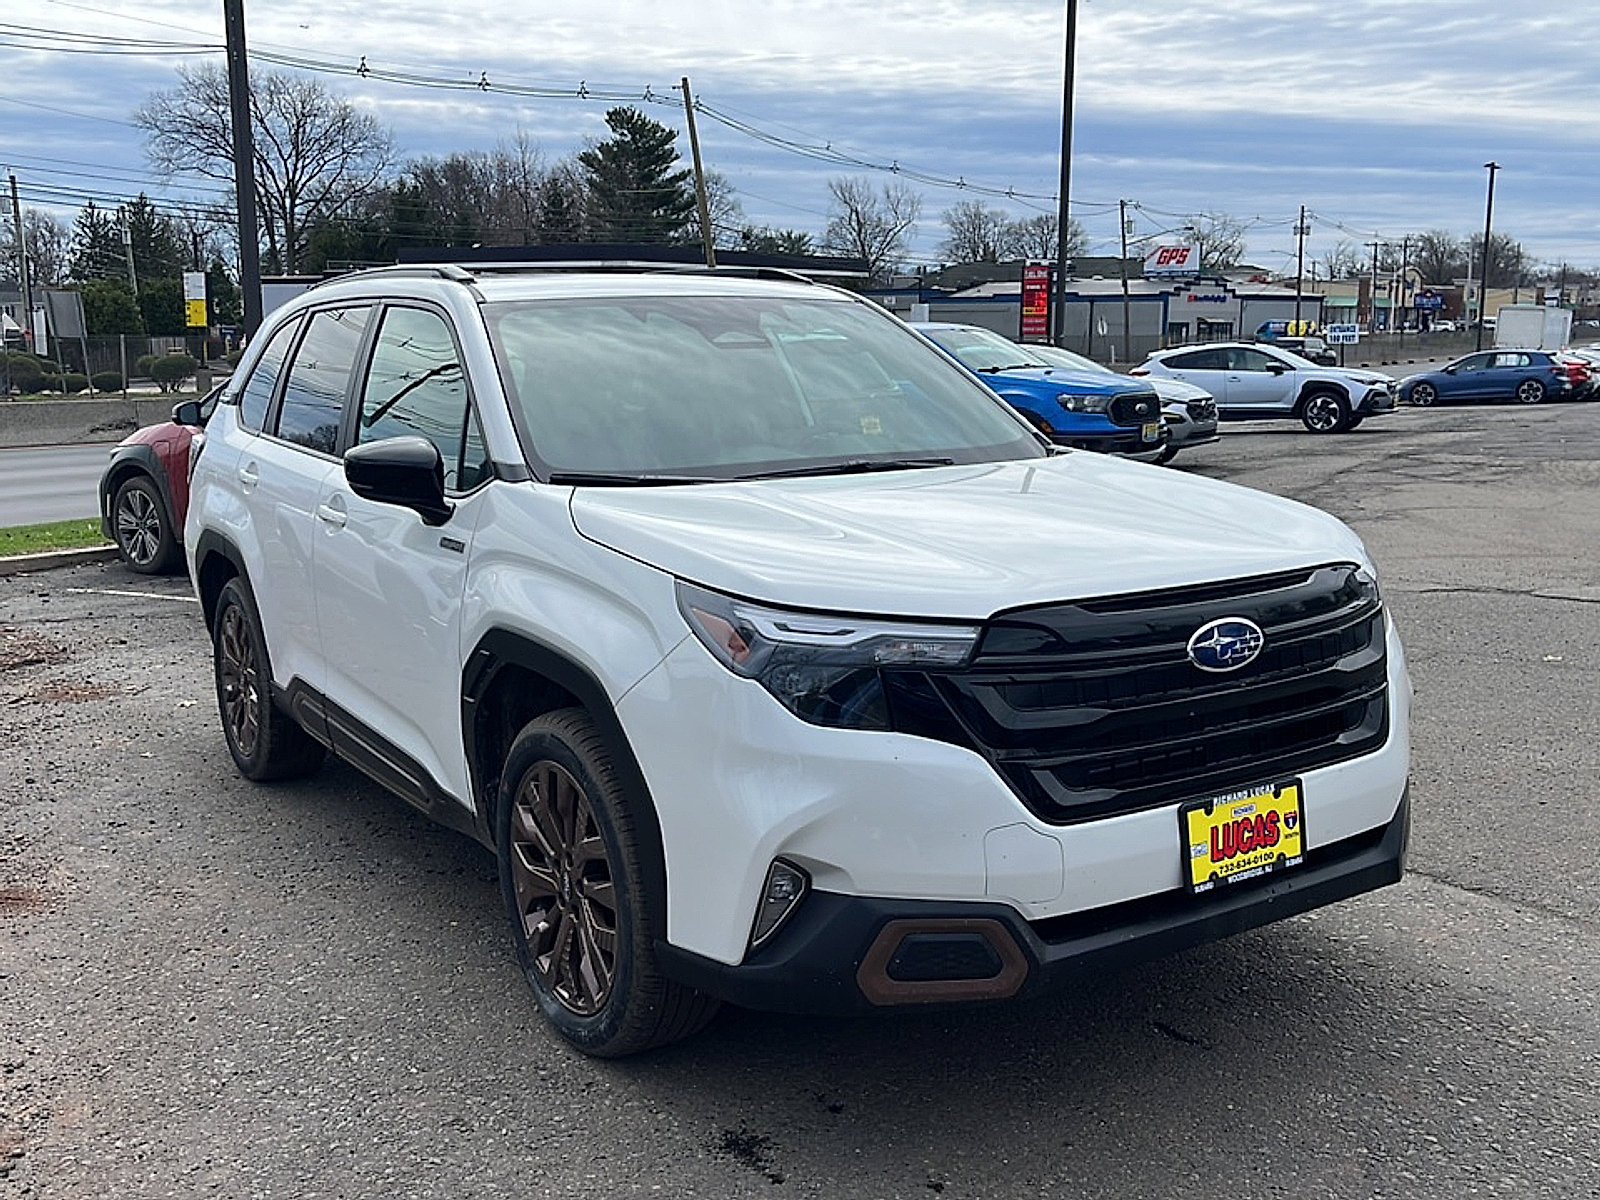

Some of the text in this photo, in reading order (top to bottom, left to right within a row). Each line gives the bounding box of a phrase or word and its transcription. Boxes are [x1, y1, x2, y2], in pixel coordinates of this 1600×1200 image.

[1157, 248, 1191, 265] GPS
[1249, 783, 1275, 798] LUCAS
[1210, 810, 1280, 863] LUCAS
